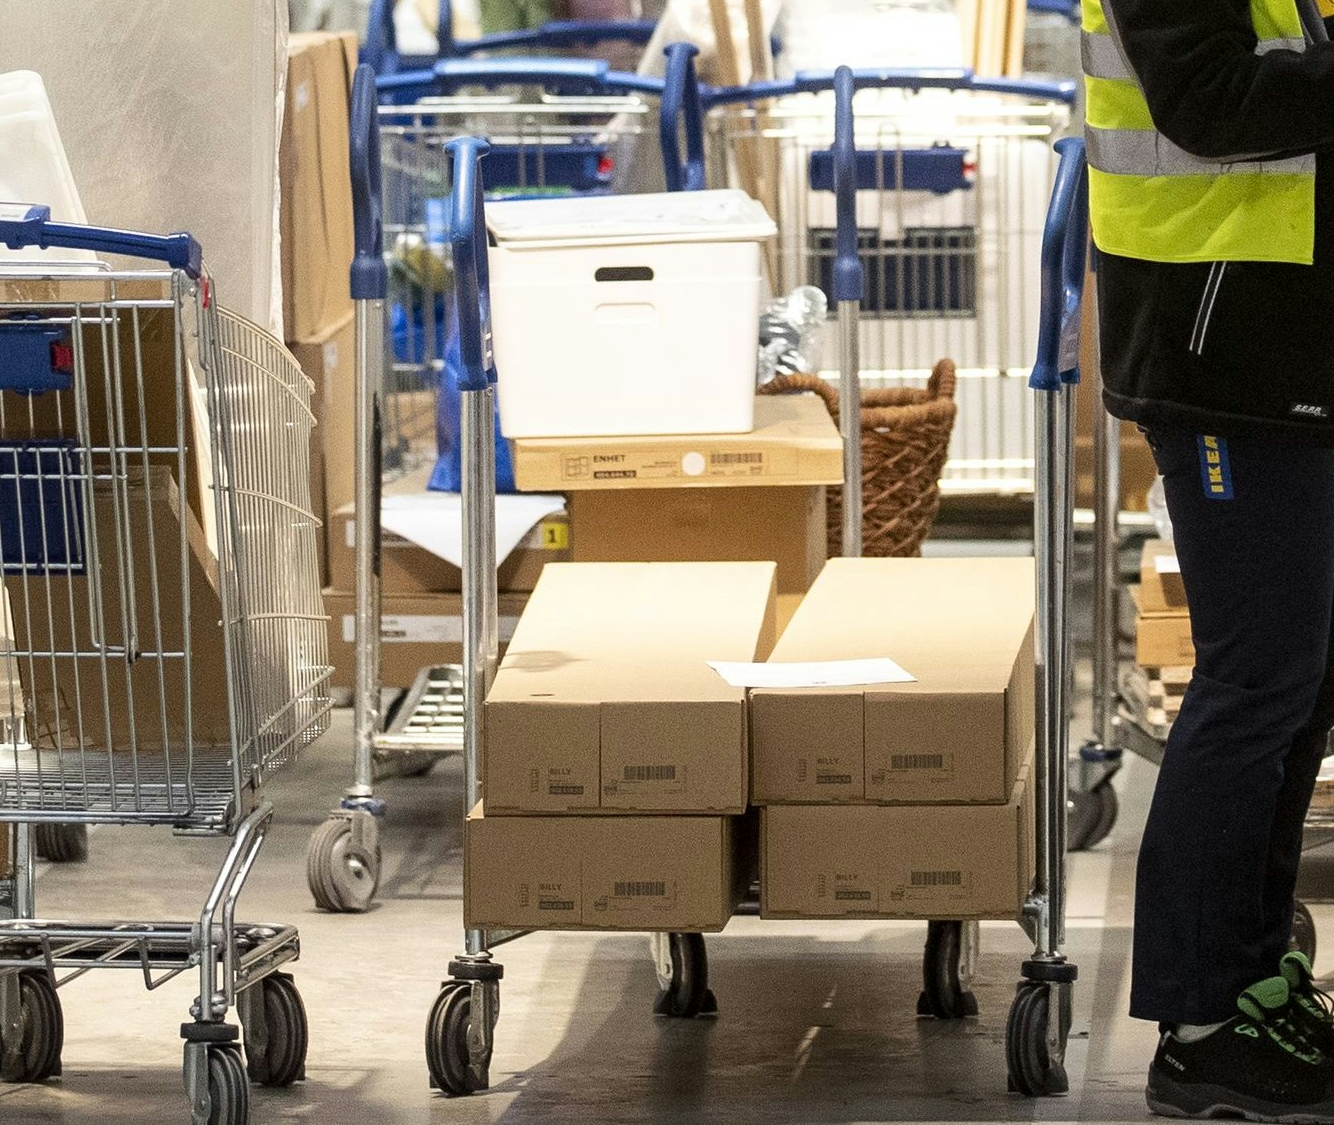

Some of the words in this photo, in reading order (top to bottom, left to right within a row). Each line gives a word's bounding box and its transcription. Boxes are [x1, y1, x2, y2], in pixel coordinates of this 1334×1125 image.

[593, 454, 626, 463] ENHET
[1204, 435, 1224, 493] IKEA
[548, 529, 556, 543] 1
